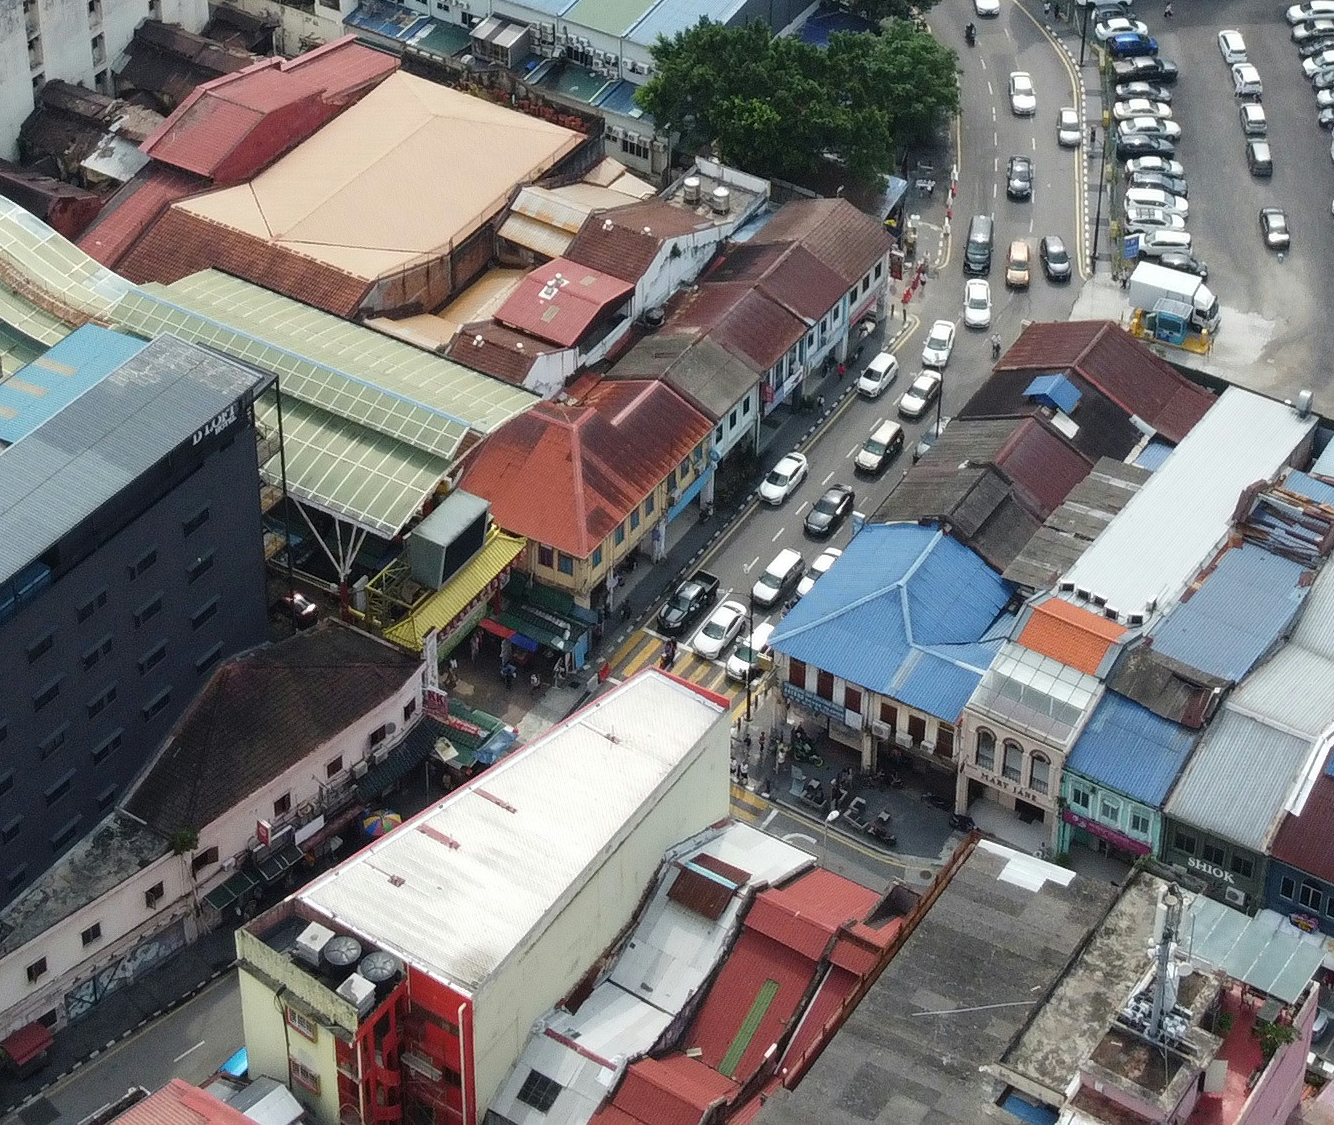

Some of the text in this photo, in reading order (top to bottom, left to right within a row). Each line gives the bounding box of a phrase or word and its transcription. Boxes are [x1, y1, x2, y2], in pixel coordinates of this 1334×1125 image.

[192, 404, 235, 447] D LOFT
[980, 772, 1038, 804] MARY JANE
[1187, 856, 1235, 885] SHIOK
